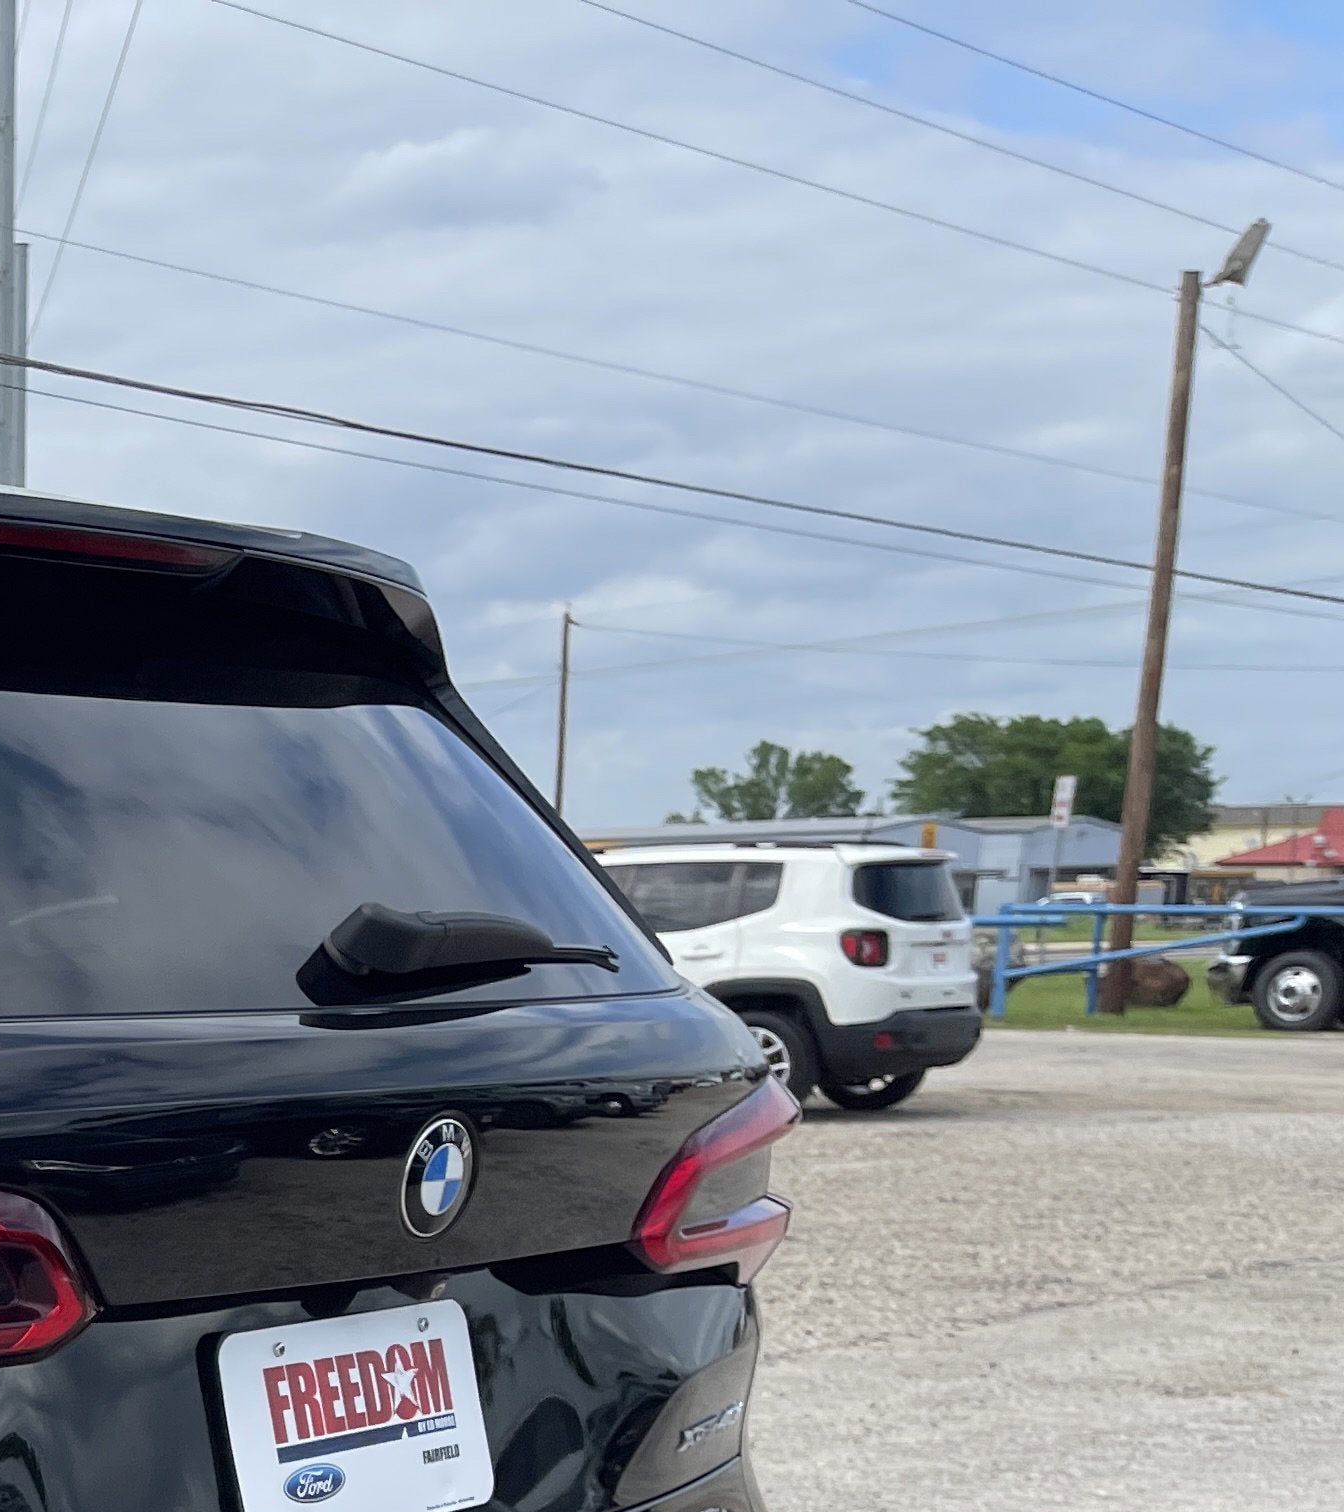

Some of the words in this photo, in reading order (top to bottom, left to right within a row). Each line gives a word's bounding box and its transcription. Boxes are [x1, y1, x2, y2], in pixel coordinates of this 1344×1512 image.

[263, 1338, 454, 1445] FREEDOM
[422, 1443, 461, 1465] FAIRFIELD
[296, 1469, 334, 1498] Ford
